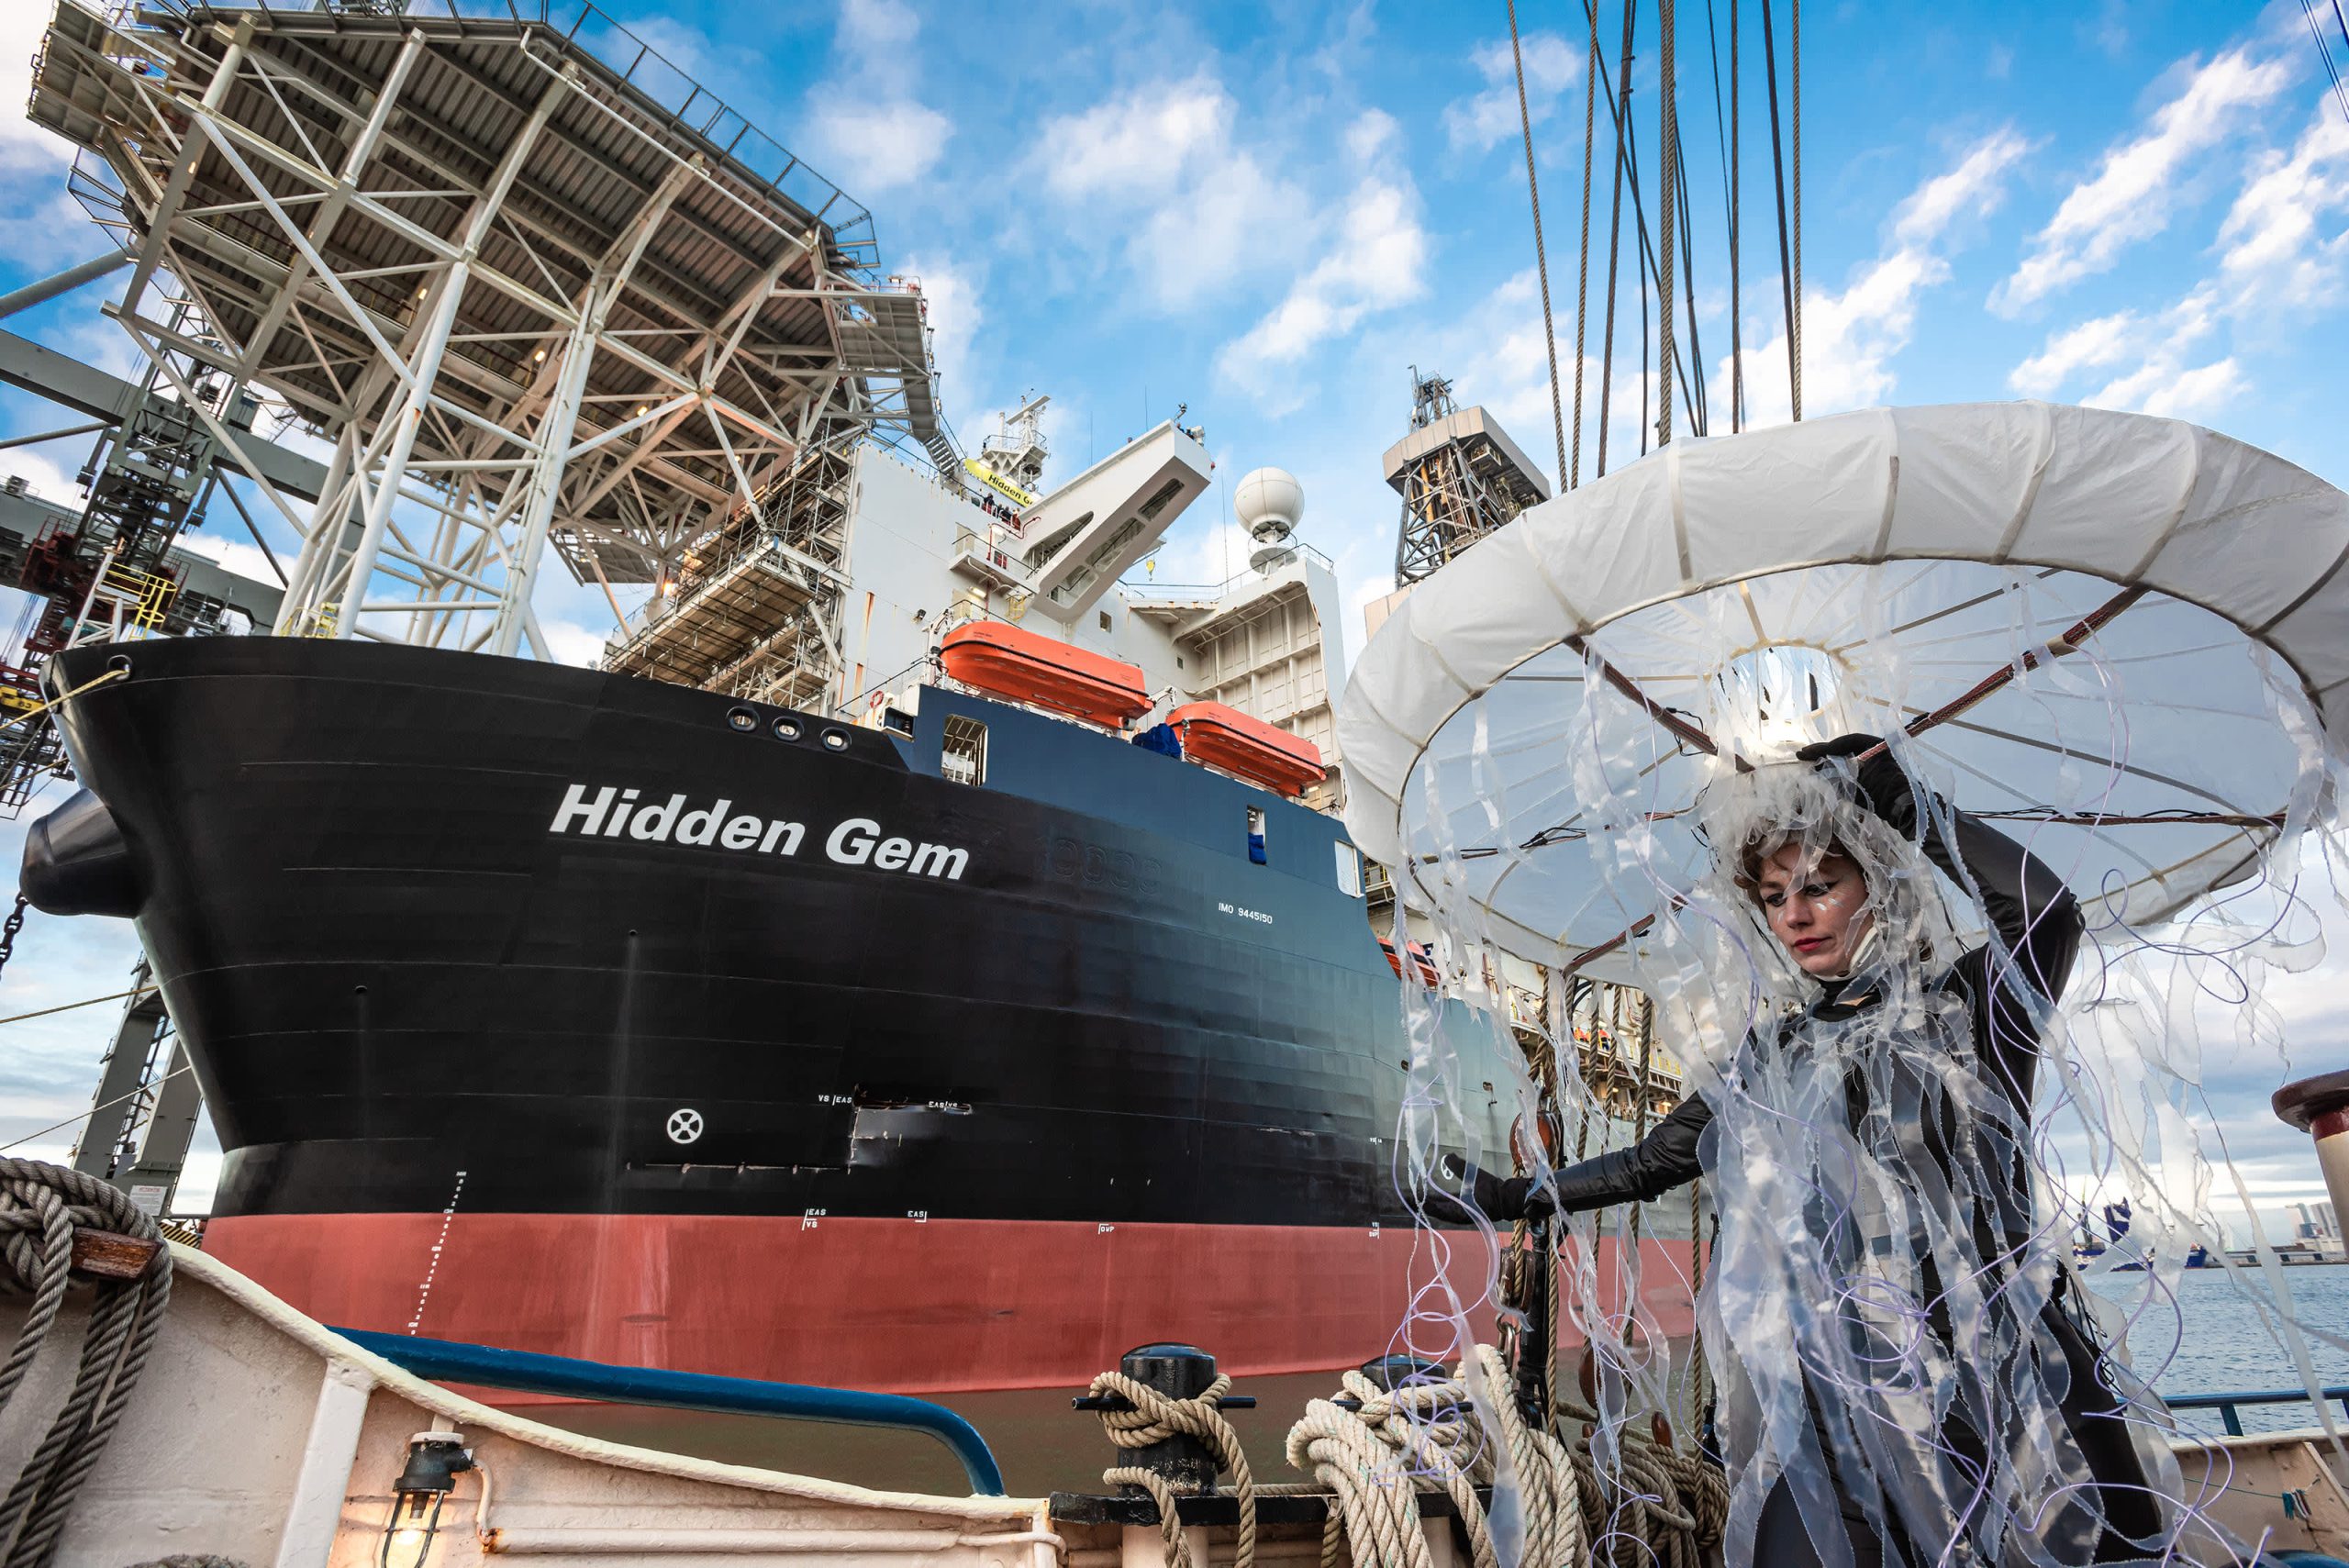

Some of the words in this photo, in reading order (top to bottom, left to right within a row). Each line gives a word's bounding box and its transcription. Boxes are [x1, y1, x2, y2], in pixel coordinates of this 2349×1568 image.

[988, 474, 1021, 499] Hidden
[549, 784, 807, 856] Hidden
[825, 817, 969, 881] Gem
[1218, 902, 1234, 915] IMO
[1238, 906, 1273, 925] 9445150
[807, 1208, 827, 1217] EAS
[806, 1220, 818, 1229] VS
